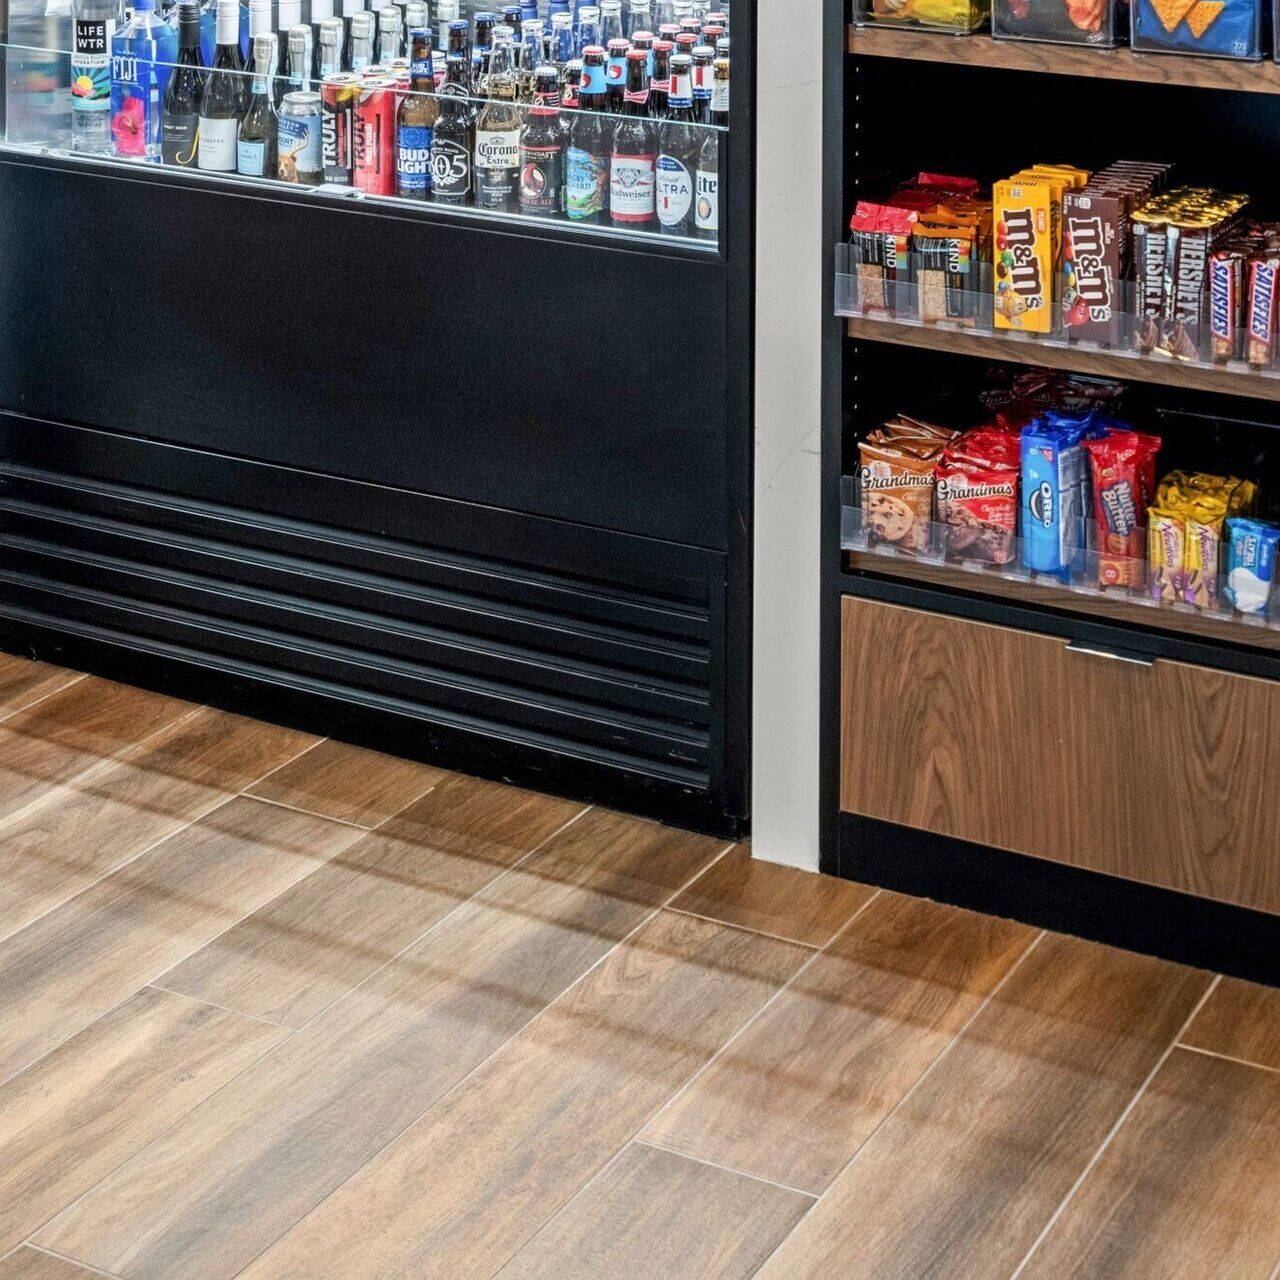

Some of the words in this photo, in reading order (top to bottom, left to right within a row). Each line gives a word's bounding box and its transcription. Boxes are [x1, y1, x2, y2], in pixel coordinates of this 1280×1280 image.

[77, 26, 104, 36] LIFE
[77, 39, 104, 48] WTR
[113, 57, 138, 81] FIJI
[322, 108, 336, 168] TRULY
[354, 113, 366, 169] TRULY
[479, 142, 518, 156] Corona
[397, 161, 432, 173] LIGHT
[399, 149, 429, 162] BUD
[487, 156, 509, 165] Extra
[886, 234, 897, 268] KIND
[949, 239, 960, 273] KIND
[1176, 237, 1205, 325] HERSHEY'S
[1210, 260, 1231, 339] SATISFIES
[1251, 262, 1274, 339] SATISFIES
[861, 466, 935, 490] Grandma's
[936, 479, 1013, 502] Grandma's
[1041, 480, 1054, 529] OREO
[1102, 490, 1128, 536] Butter
[1114, 481, 1137, 528] Nutter
